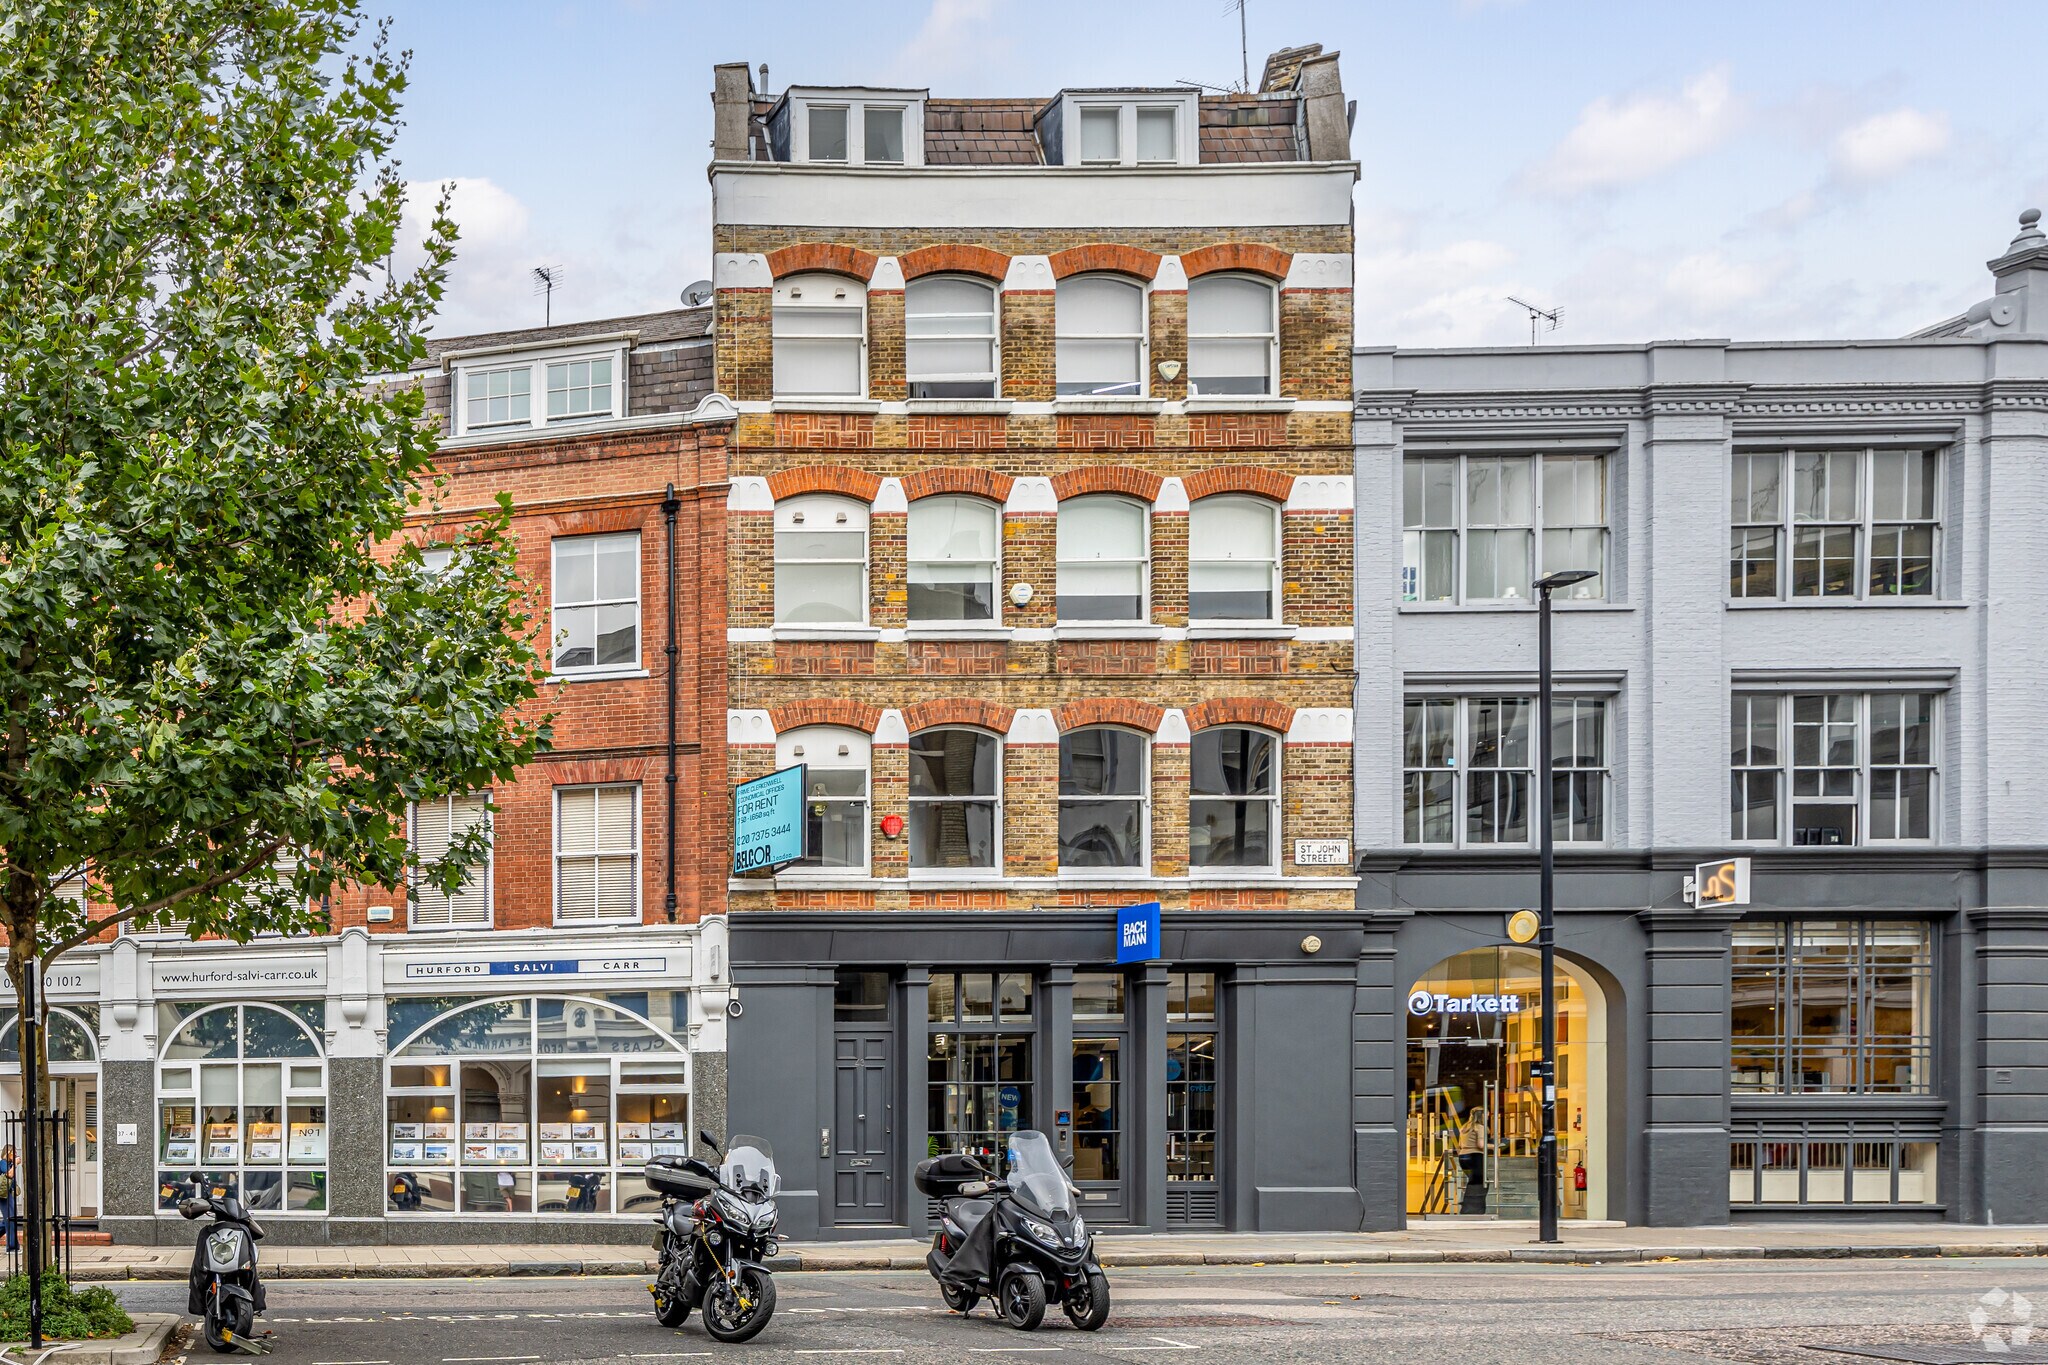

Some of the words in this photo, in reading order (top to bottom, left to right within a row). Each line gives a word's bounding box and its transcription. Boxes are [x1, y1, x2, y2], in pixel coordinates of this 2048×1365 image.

[751, 778, 782, 791] CLERKENWELL
[765, 784, 785, 796] OFFICES
[738, 802, 753, 817] FOR
[755, 795, 778, 811] RENT
[737, 834, 749, 846] 020
[751, 829, 770, 842] 7375
[771, 823, 791, 837] 3444
[1301, 845, 1314, 853] ST.
[1317, 845, 1340, 853] JOHN
[1301, 854, 1333, 862] STREET
[1123, 920, 1147, 936] BACH
[1123, 933, 1147, 947] MANN
[416, 965, 481, 975] HURFORD
[513, 963, 554, 972] SALVI
[603, 961, 640, 970] CARR
[57, 976, 82, 987] 1012
[161, 968, 318, 983] www.hurford-salvi-carr.co.uk
[1433, 993, 1519, 1013] Tarkett
[1001, 1093, 1018, 1101] NEW
